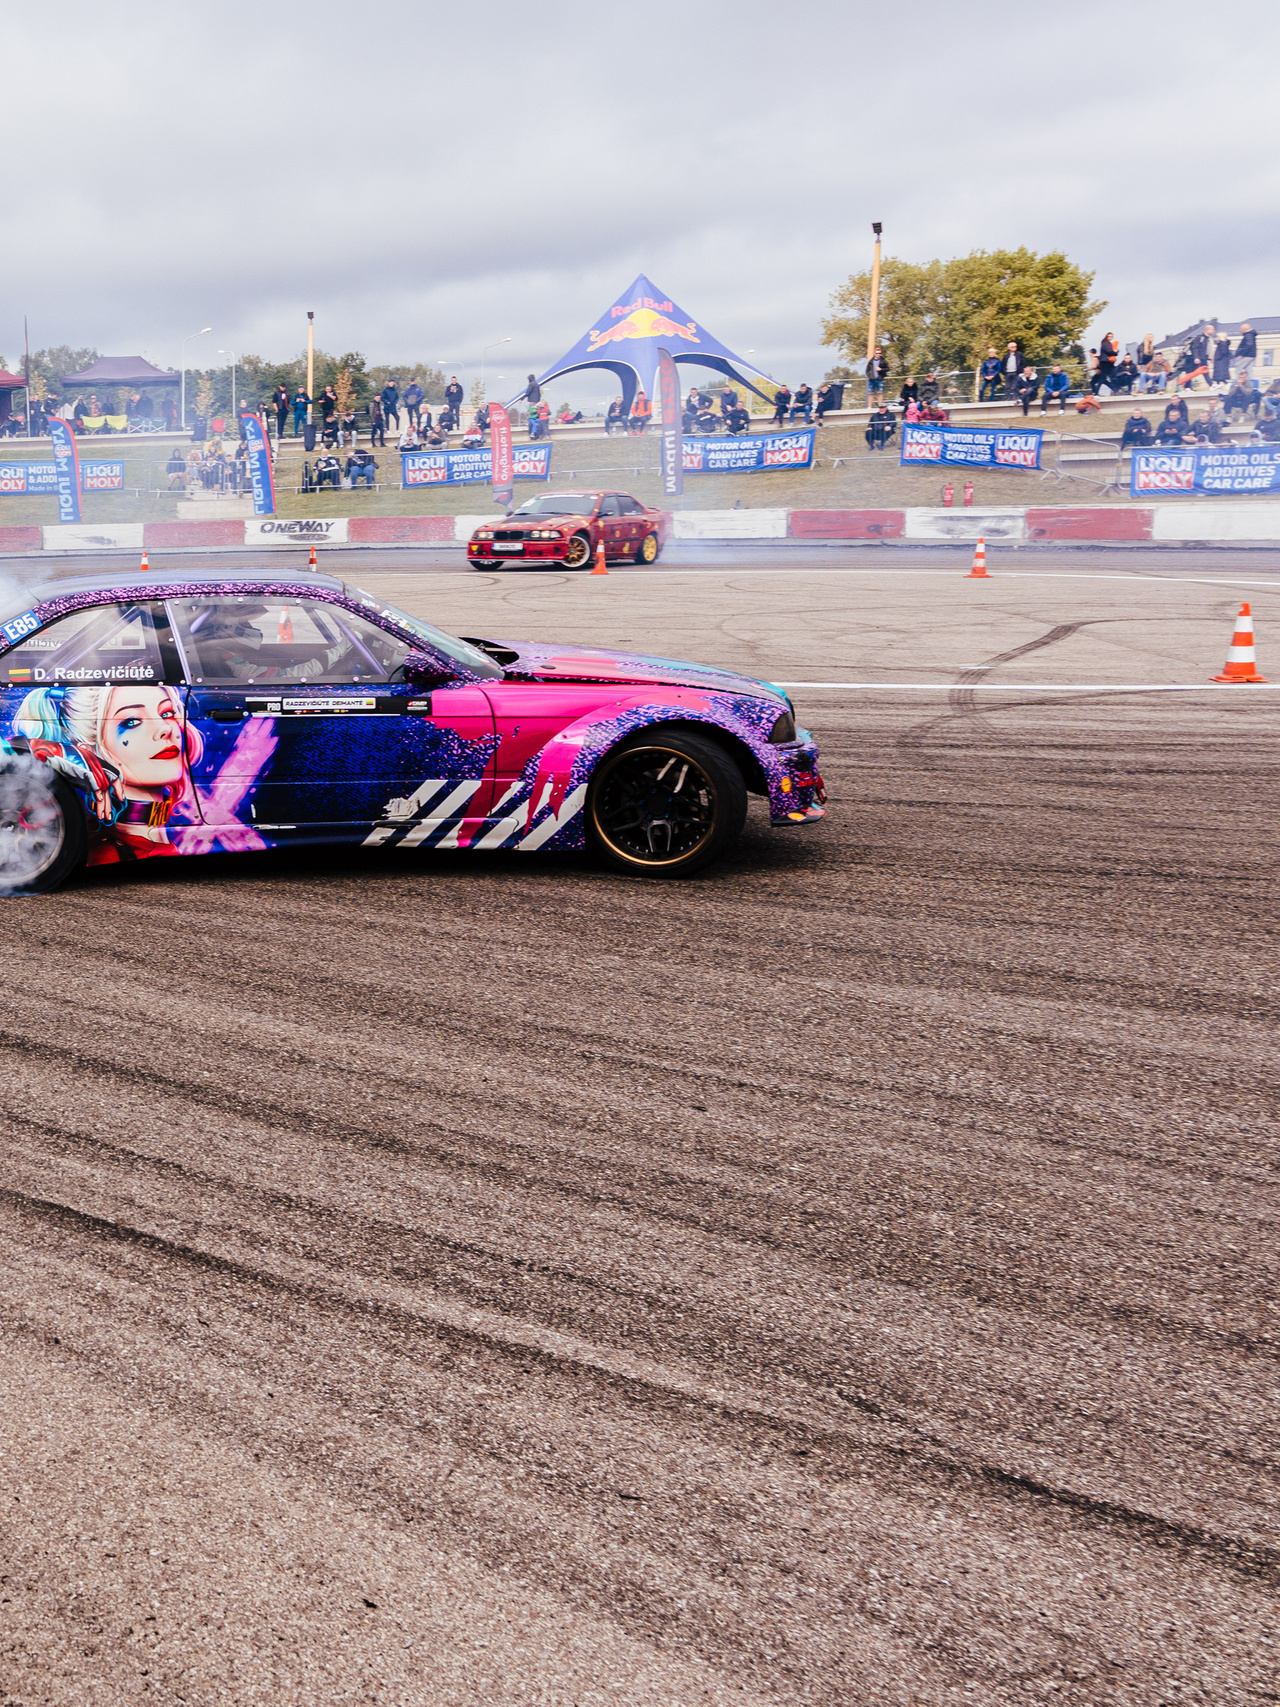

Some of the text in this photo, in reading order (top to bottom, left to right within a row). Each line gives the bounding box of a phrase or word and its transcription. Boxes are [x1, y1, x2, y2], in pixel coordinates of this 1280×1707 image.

[611, 297, 673, 318] Red Bull
[767, 436, 807, 450] LIQUI
[944, 433, 995, 444] MOTOR OILS
[999, 436, 1036, 450] LIQUI
[706, 440, 762, 450] MOTOR OILS
[906, 444, 940, 458] MOLY
[449, 453, 491, 464] MOTOR OI
[708, 450, 758, 459] ADDITIVES
[766, 449, 807, 463] MOLY
[998, 450, 1036, 465] MOLY
[1200, 455, 1248, 466] MOTOR
[408, 457, 444, 470] LIQUI
[453, 462, 492, 471] ADDITIVE
[709, 459, 757, 468] CAR CARE
[1140, 457, 1193, 472] LIQUI
[86, 466, 120, 477] LIQUI
[408, 469, 445, 482] MOLY
[454, 472, 472, 480] CAR
[1202, 466, 1276, 478] ADDITIVES
[86, 477, 121, 488] MOLY
[1139, 473, 1193, 488] MOLY
[1203, 478, 1272, 488] CAR CARE
[3, 613, 39, 641] E85
[34, 665, 154, 680] D. Radzevičiūtė
[267, 702, 281, 711] PRO
